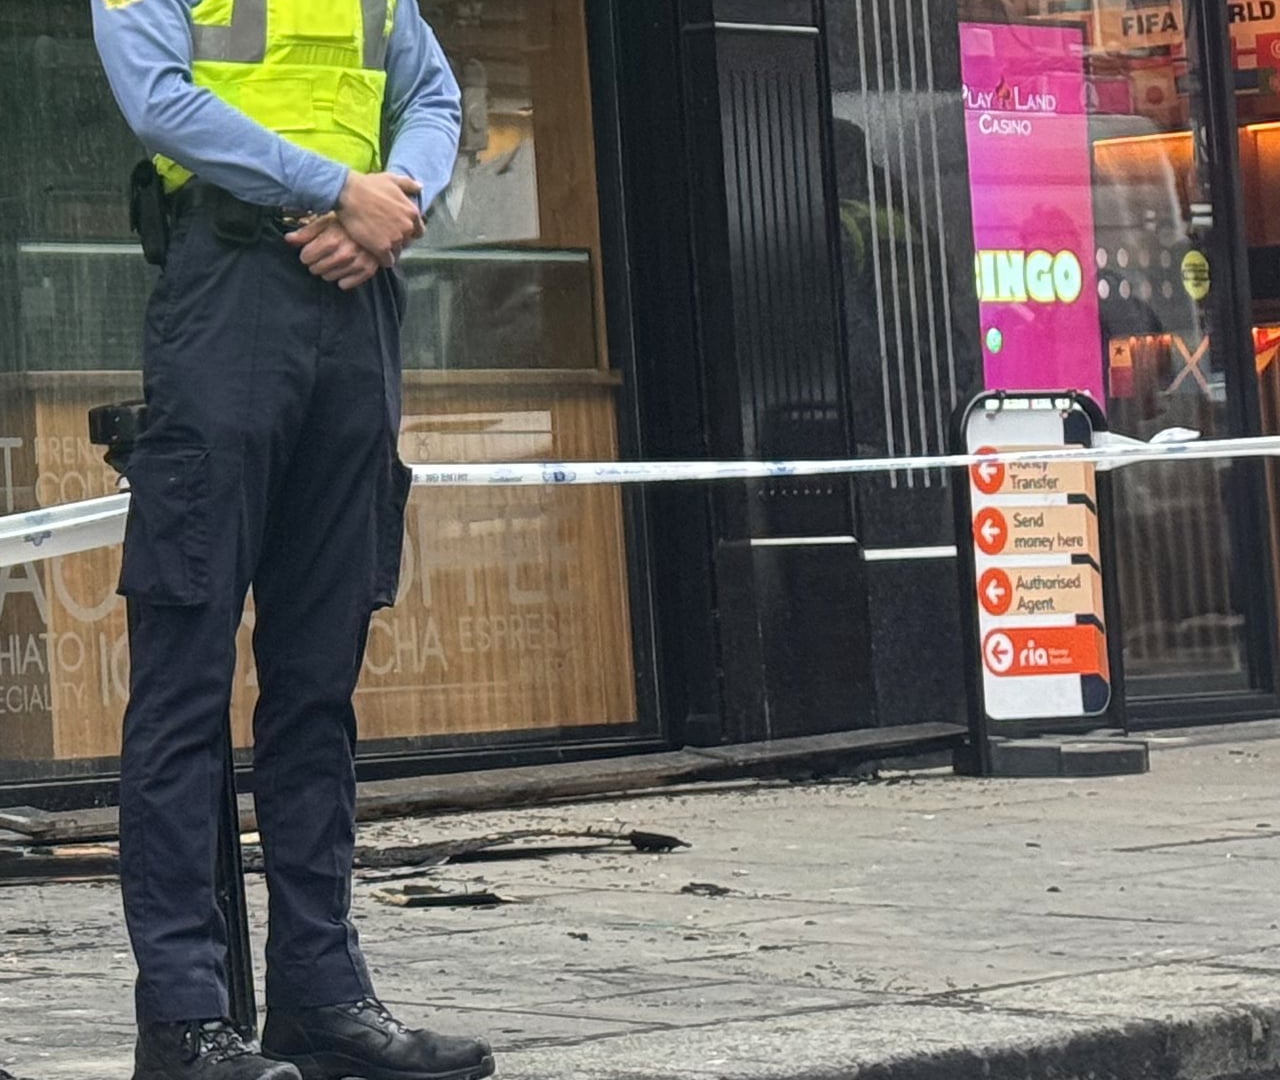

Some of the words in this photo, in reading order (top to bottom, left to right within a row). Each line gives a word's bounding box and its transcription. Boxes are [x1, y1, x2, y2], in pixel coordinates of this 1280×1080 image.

[1226, 1, 1276, 23] RLD
[1122, 11, 1179, 37] FIFA
[1014, 85, 1057, 112] LAND
[979, 114, 1032, 136] CASINO
[975, 250, 1083, 304] INGO
[1009, 475, 1059, 489] Transfer
[1013, 512, 1044, 528] Send
[1014, 536, 1055, 551] money
[1058, 532, 1083, 547] here
[1016, 574, 1081, 589] Authorised
[1017, 596, 1055, 614] Agent
[366, 617, 448, 675] CHA
[1019, 639, 1048, 667] ria
